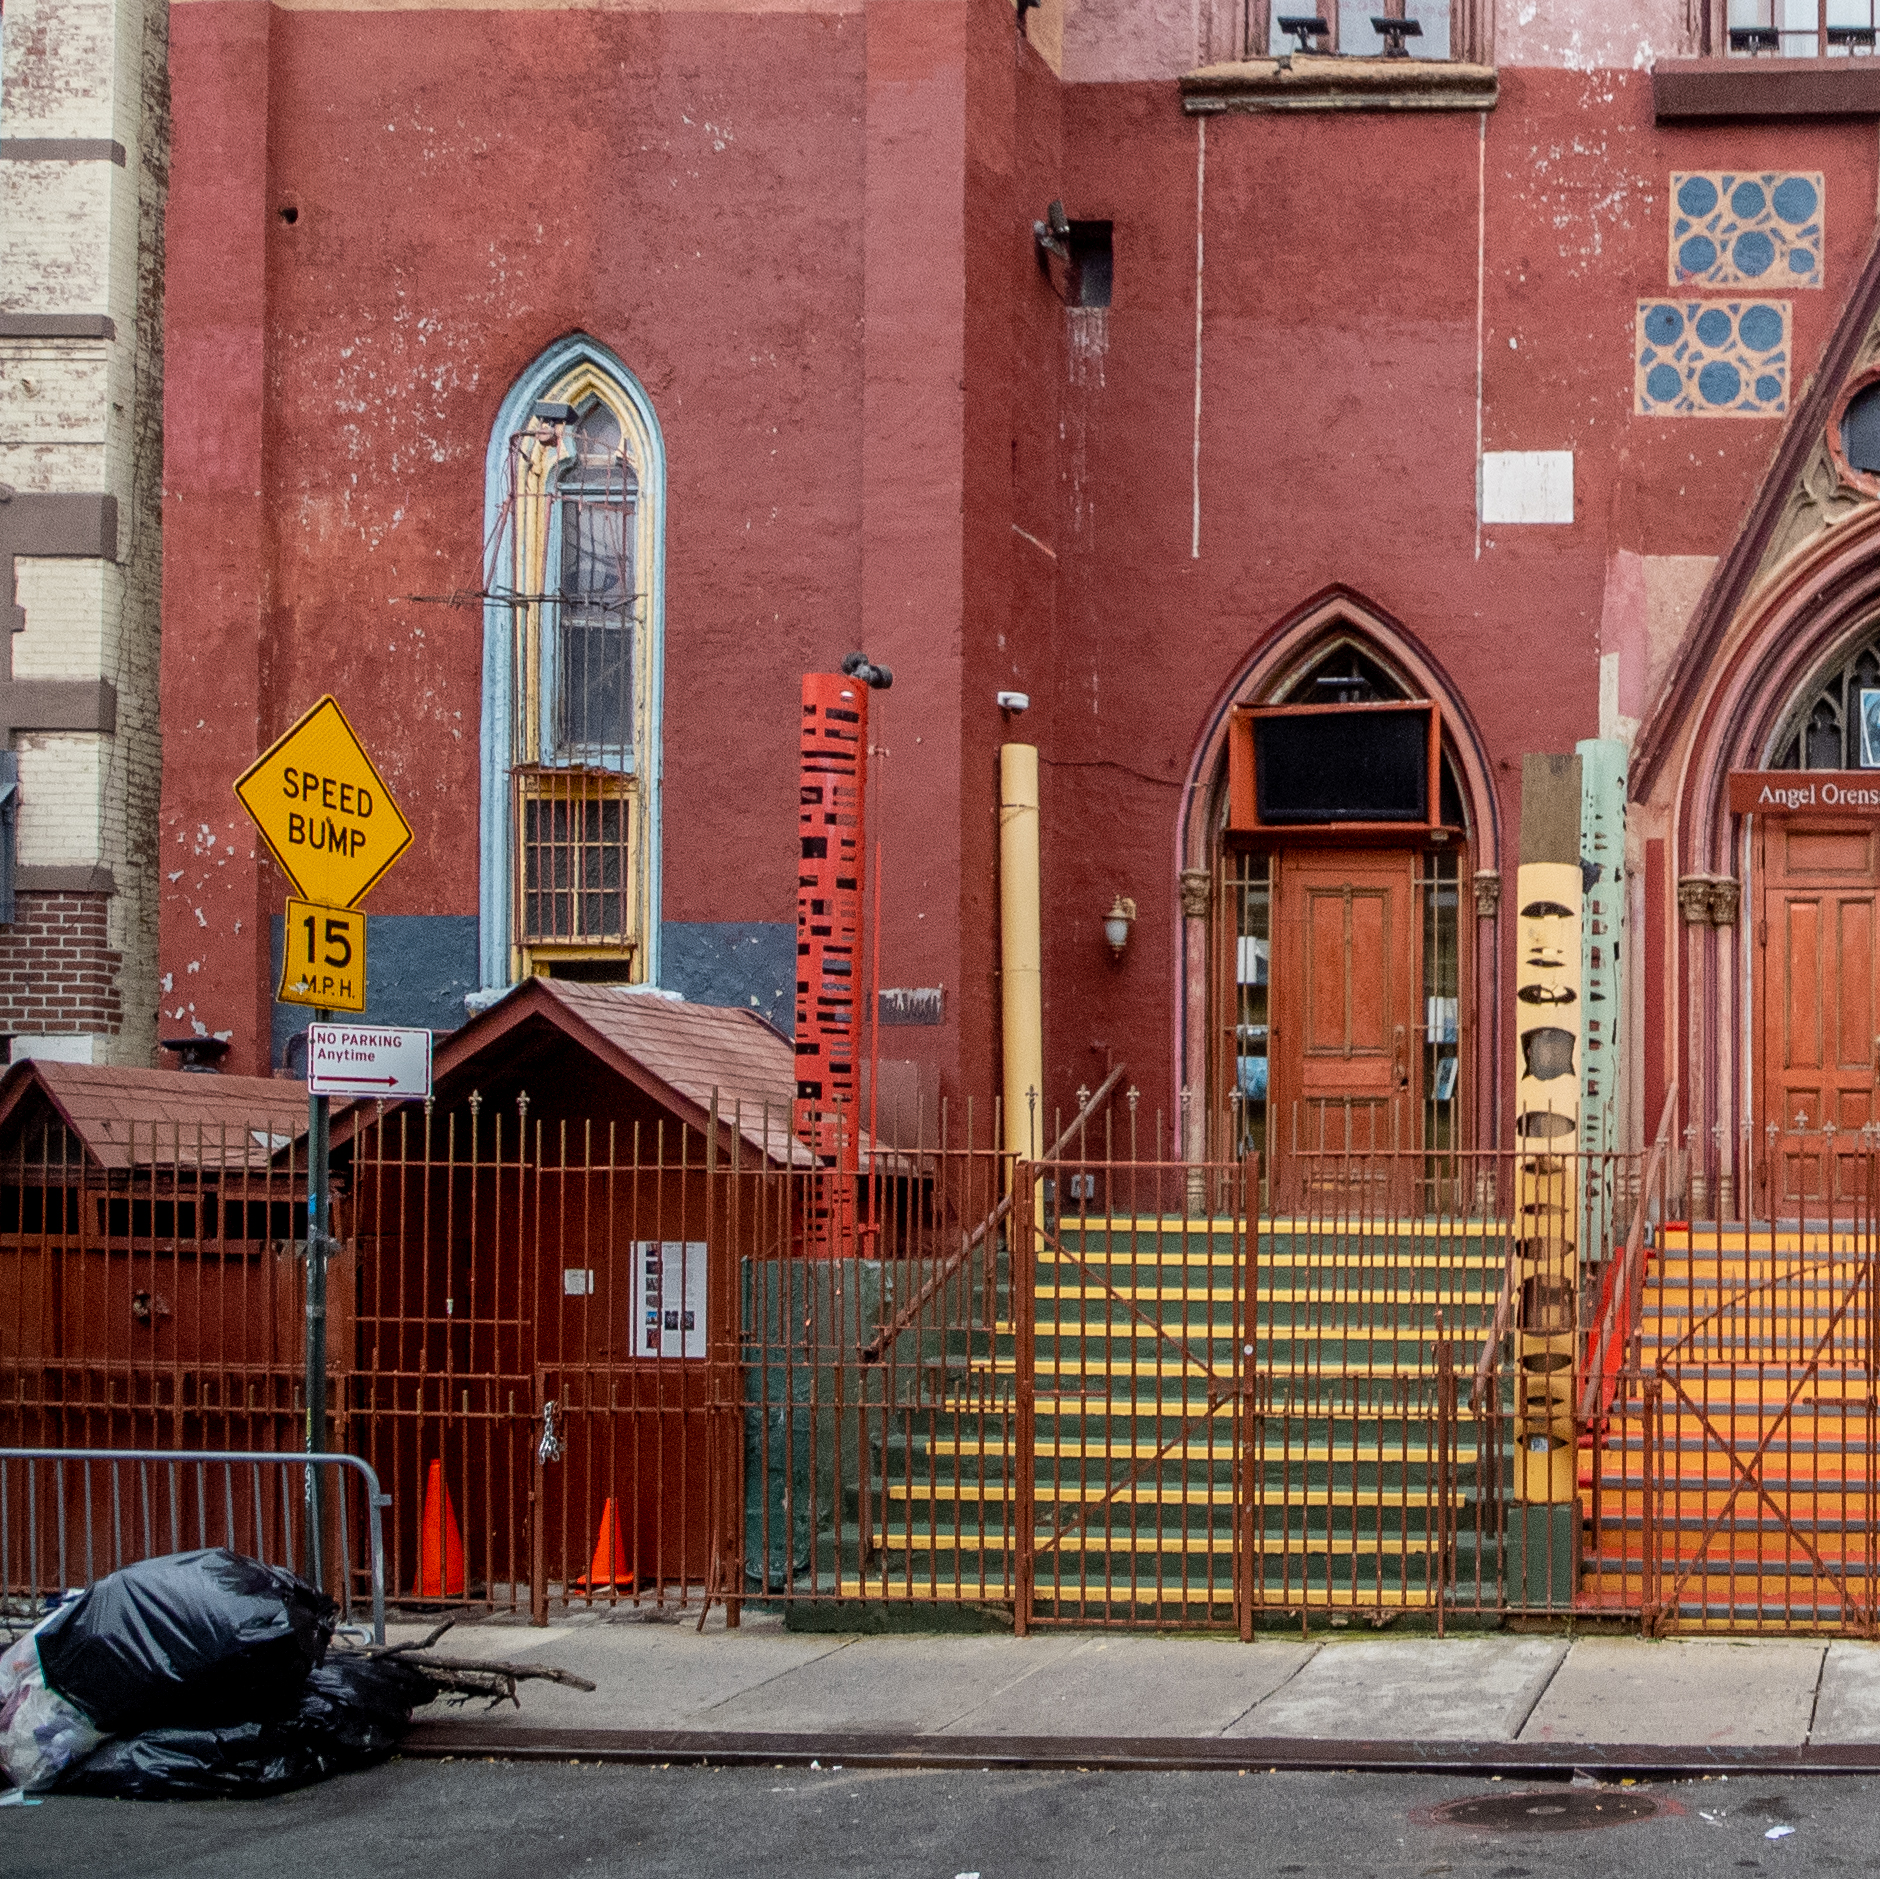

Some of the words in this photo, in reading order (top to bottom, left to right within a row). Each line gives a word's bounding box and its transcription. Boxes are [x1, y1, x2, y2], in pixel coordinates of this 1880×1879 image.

[282, 767, 373, 818] SPEED
[1758, 784, 1816, 808] Angel
[288, 813, 367, 859] BUMP
[303, 916, 353, 967] 15
[301, 973, 356, 1000] M.P.H.
[317, 1032, 337, 1045] NO
[341, 1033, 403, 1048] PARKING
[317, 1049, 376, 1063] Anytime
